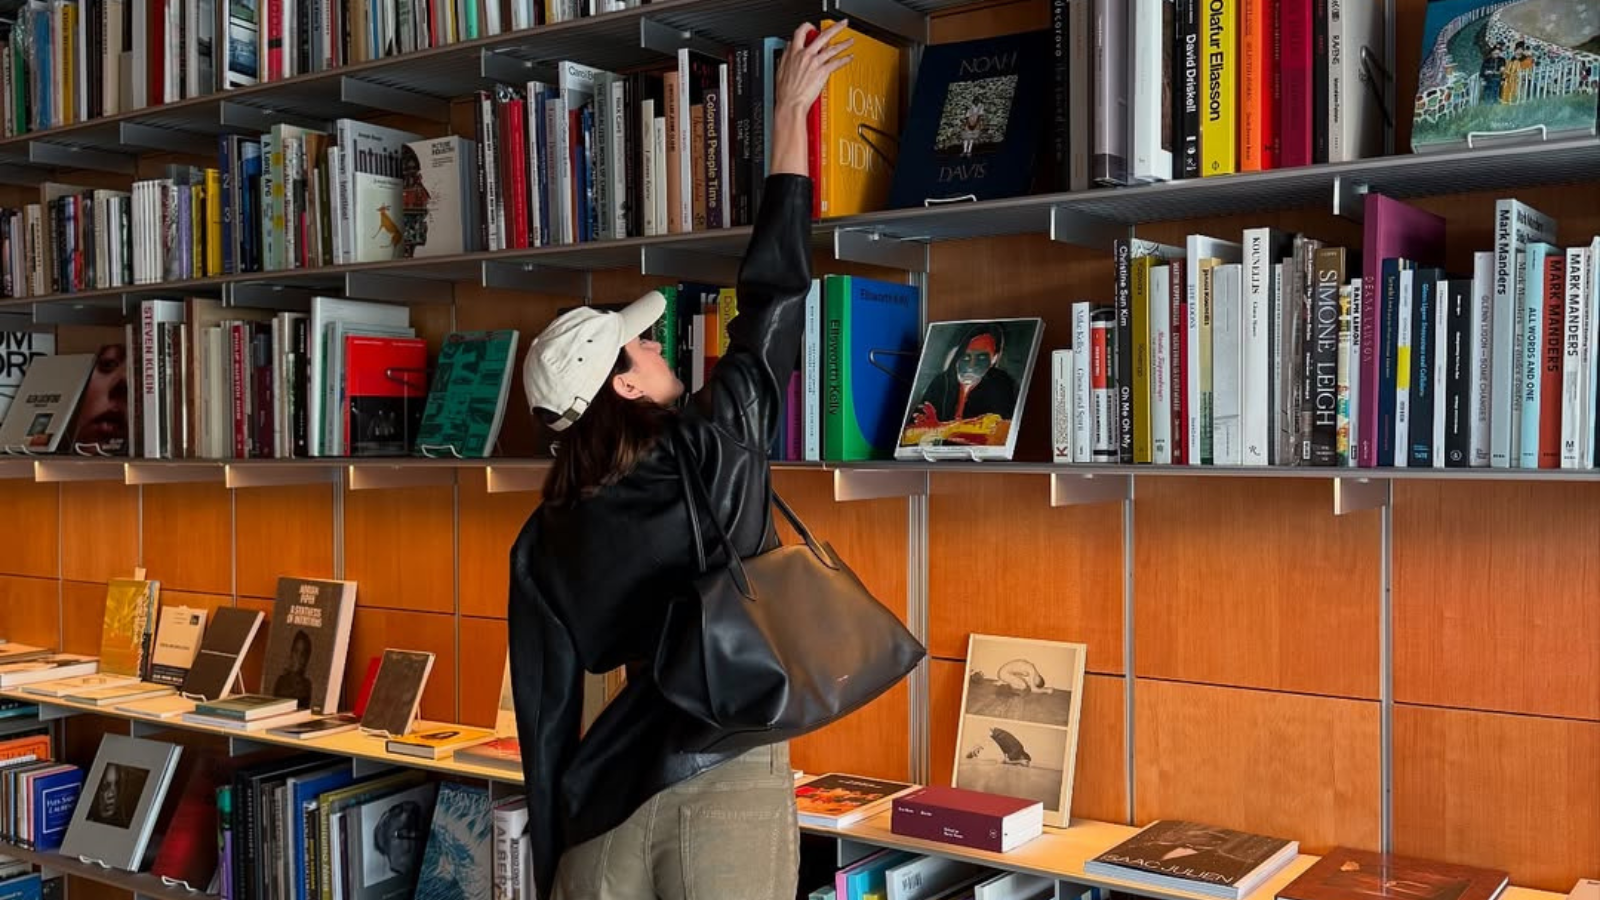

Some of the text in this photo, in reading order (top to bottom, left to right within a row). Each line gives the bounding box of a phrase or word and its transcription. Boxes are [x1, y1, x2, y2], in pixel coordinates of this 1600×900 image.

[959, 51, 1019, 80] NOAH
[1185, 34, 1197, 67] David
[1209, 0, 1224, 122] Olafur Eliasson
[1332, 35, 1340, 66] RAVENS
[846, 86, 885, 124] JOAN
[1185, 69, 1197, 113] Driskell
[222, 173, 231, 188] 2
[264, 151, 274, 177] Long
[706, 94, 719, 209] Colored People Time
[938, 163, 987, 188] DAVIS
[223, 206, 232, 223] 3
[1119, 245, 1129, 327] Christine Sun Kim
[1251, 237, 1261, 295] KOUNELLIS
[1496, 209, 1511, 296] Mark Manders
[1363, 276, 1374, 363] DEANA LAWSON
[1547, 259, 1563, 373] MARK MANDERS
[1567, 253, 1582, 357] MARK MANDERS
[143, 306, 155, 396] STEVEN KLEIN
[828, 319, 842, 417] Ellsworth Kelly
[1315, 269, 1338, 427] SIMONE LEIGH
[1478, 295, 1490, 422] GLENN LIGON SOME CHANGES
[1525, 307, 1538, 402] ALL WORDS AND ONE
[1121, 386, 1132, 449] Oh Me Oh My
[1098, 854, 1234, 885] ISAAC JULIEN
